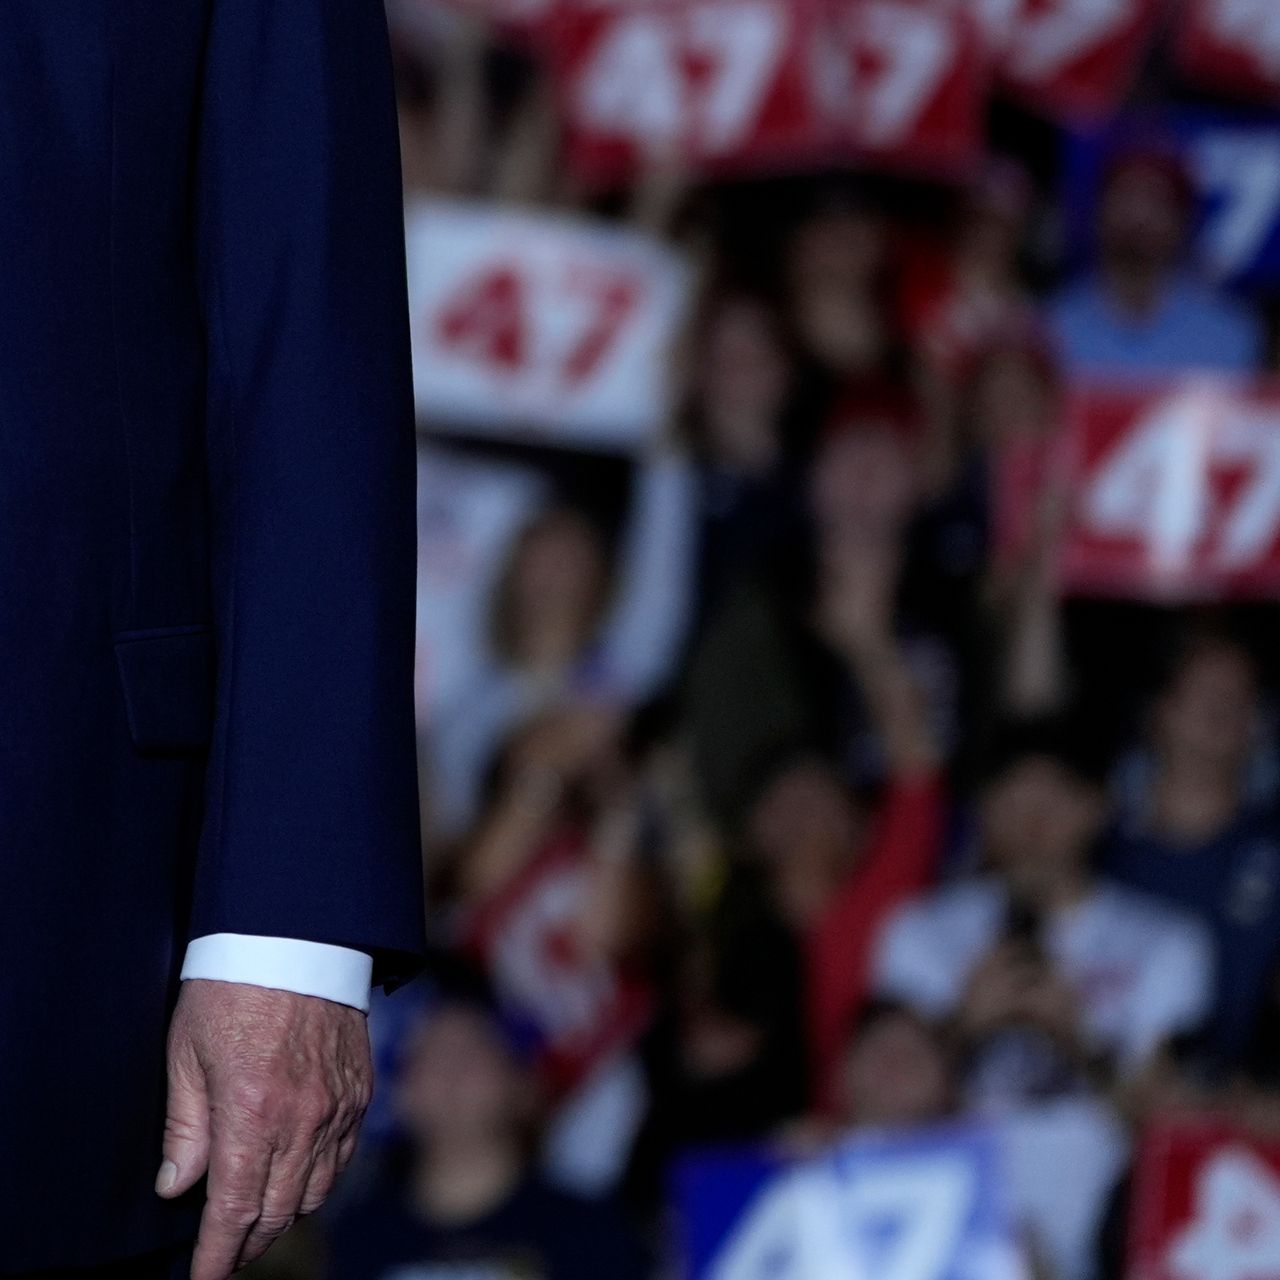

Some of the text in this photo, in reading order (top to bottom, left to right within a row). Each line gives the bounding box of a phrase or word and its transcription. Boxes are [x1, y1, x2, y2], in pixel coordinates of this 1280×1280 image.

[1190, 128, 1280, 280] 7
[436, 254, 646, 392] 47
[1076, 370, 1280, 584] 47
[700, 1146, 980, 1280] 47
[1165, 1144, 1280, 1280] 4
